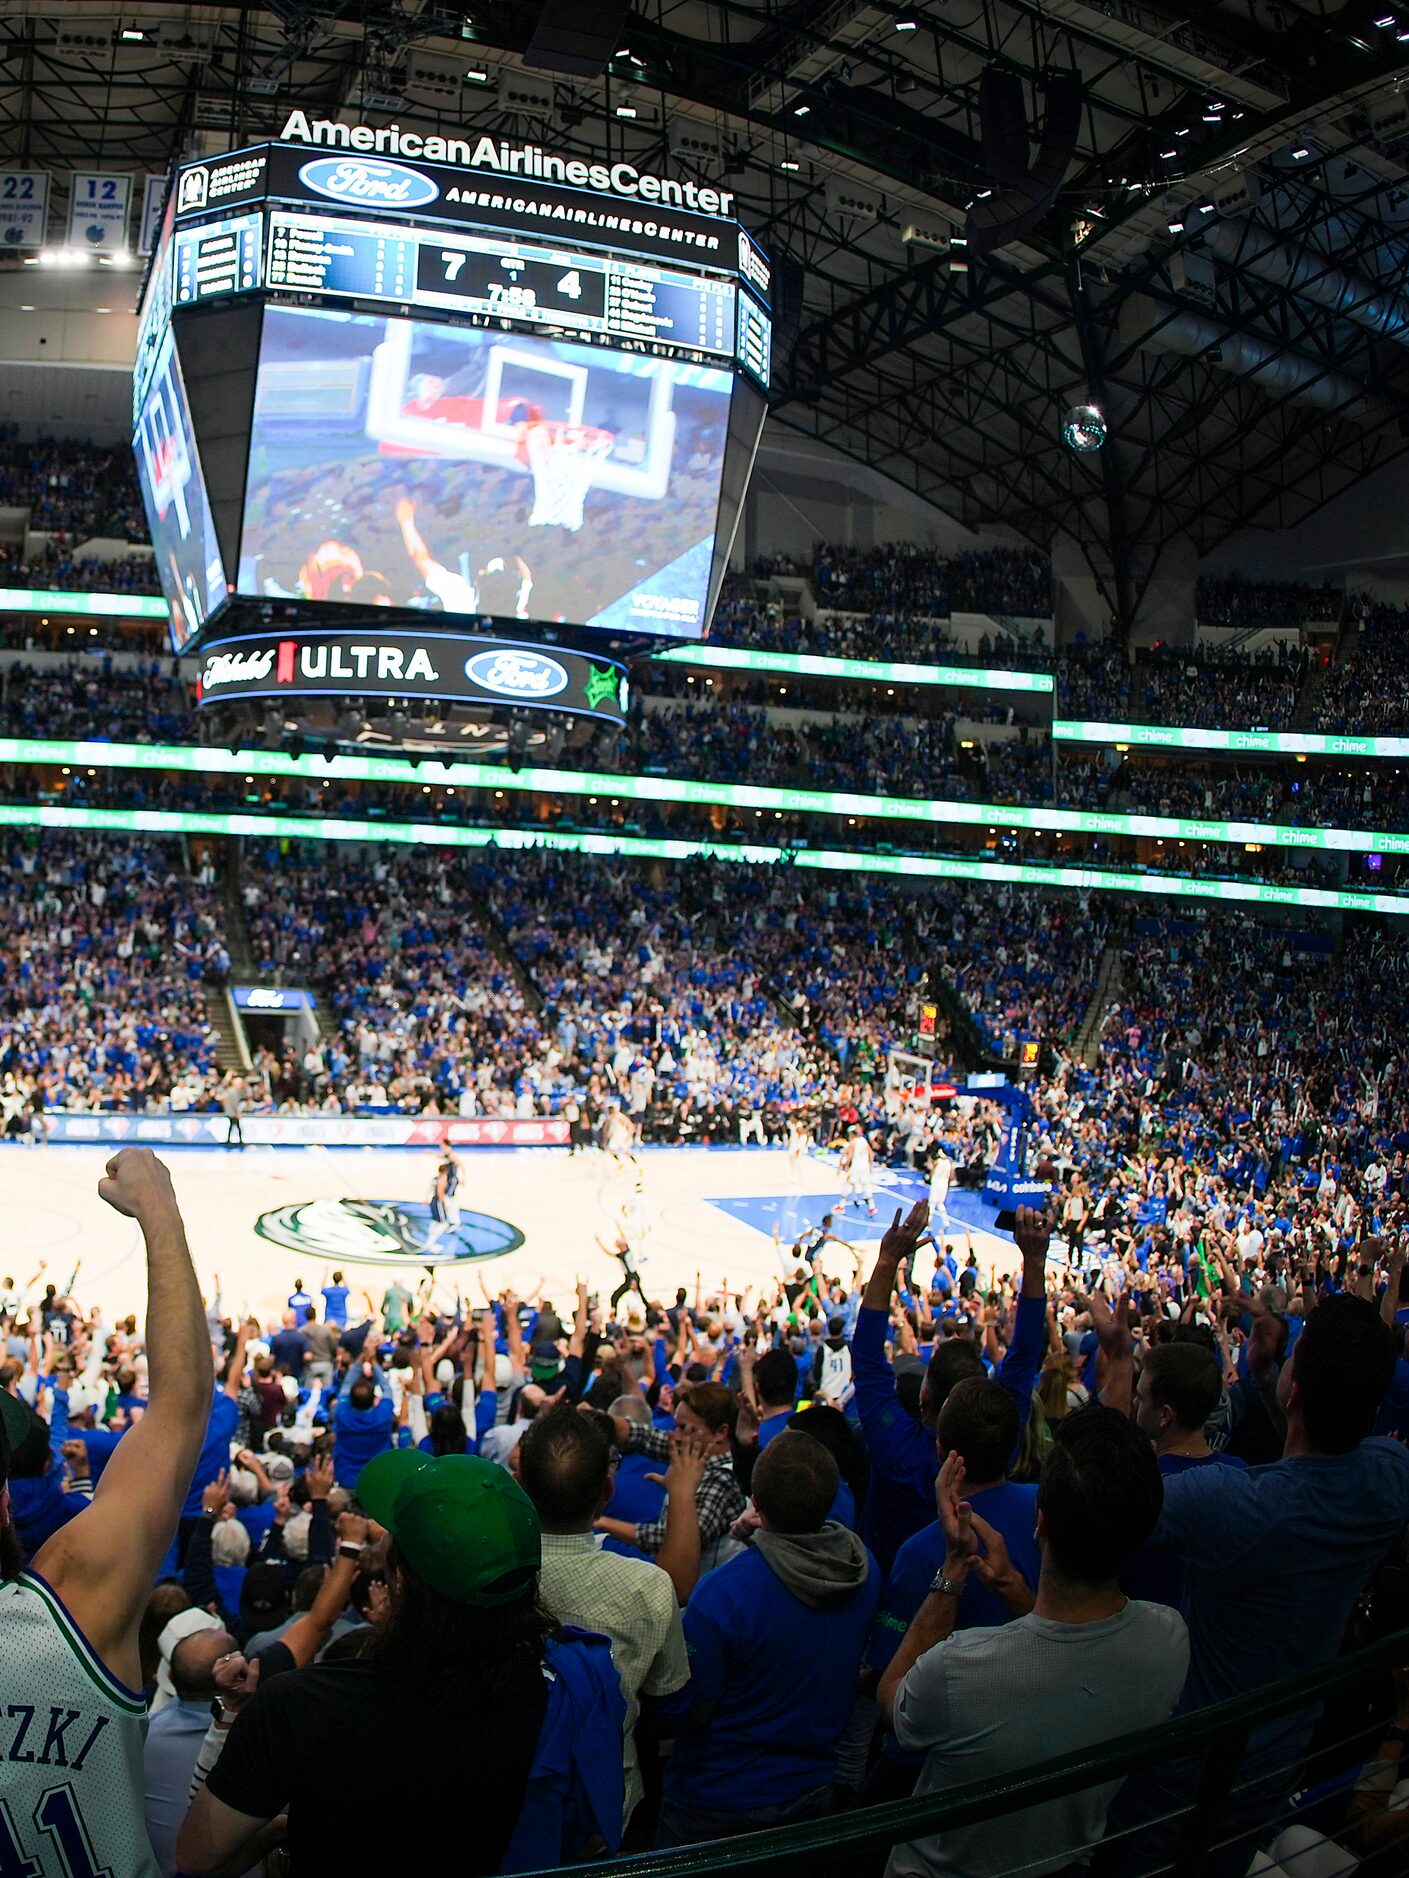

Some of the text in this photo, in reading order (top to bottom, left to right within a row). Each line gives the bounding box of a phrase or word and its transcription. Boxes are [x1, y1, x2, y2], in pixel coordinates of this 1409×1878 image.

[3, 177, 34, 199] 22
[326, 162, 412, 201] Ford
[88, 180, 117, 199] 12
[442, 252, 466, 280] 7
[500, 258, 525, 271] QTR
[509, 270, 518, 282] 1
[557, 271, 582, 299] 4
[301, 646, 440, 681] ULTRA
[486, 654, 552, 690] Ford
[1138, 730, 1173, 744] chime
[1236, 734, 1270, 748] chime
[1332, 739, 1366, 753] chime
[788, 794, 824, 809] chime
[888, 801, 924, 816] chime
[988, 808, 1024, 822] chime
[1086, 816, 1122, 830] chime
[1186, 823, 1221, 838] chime
[1282, 830, 1318, 844] chime
[1026, 869, 1056, 882] chime
[1106, 874, 1136, 888] chime
[1186, 882, 1215, 894] chime
[1264, 888, 1292, 900] chime
[1343, 896, 1370, 908] chime
[1012, 1181, 1052, 1194] coinbase
